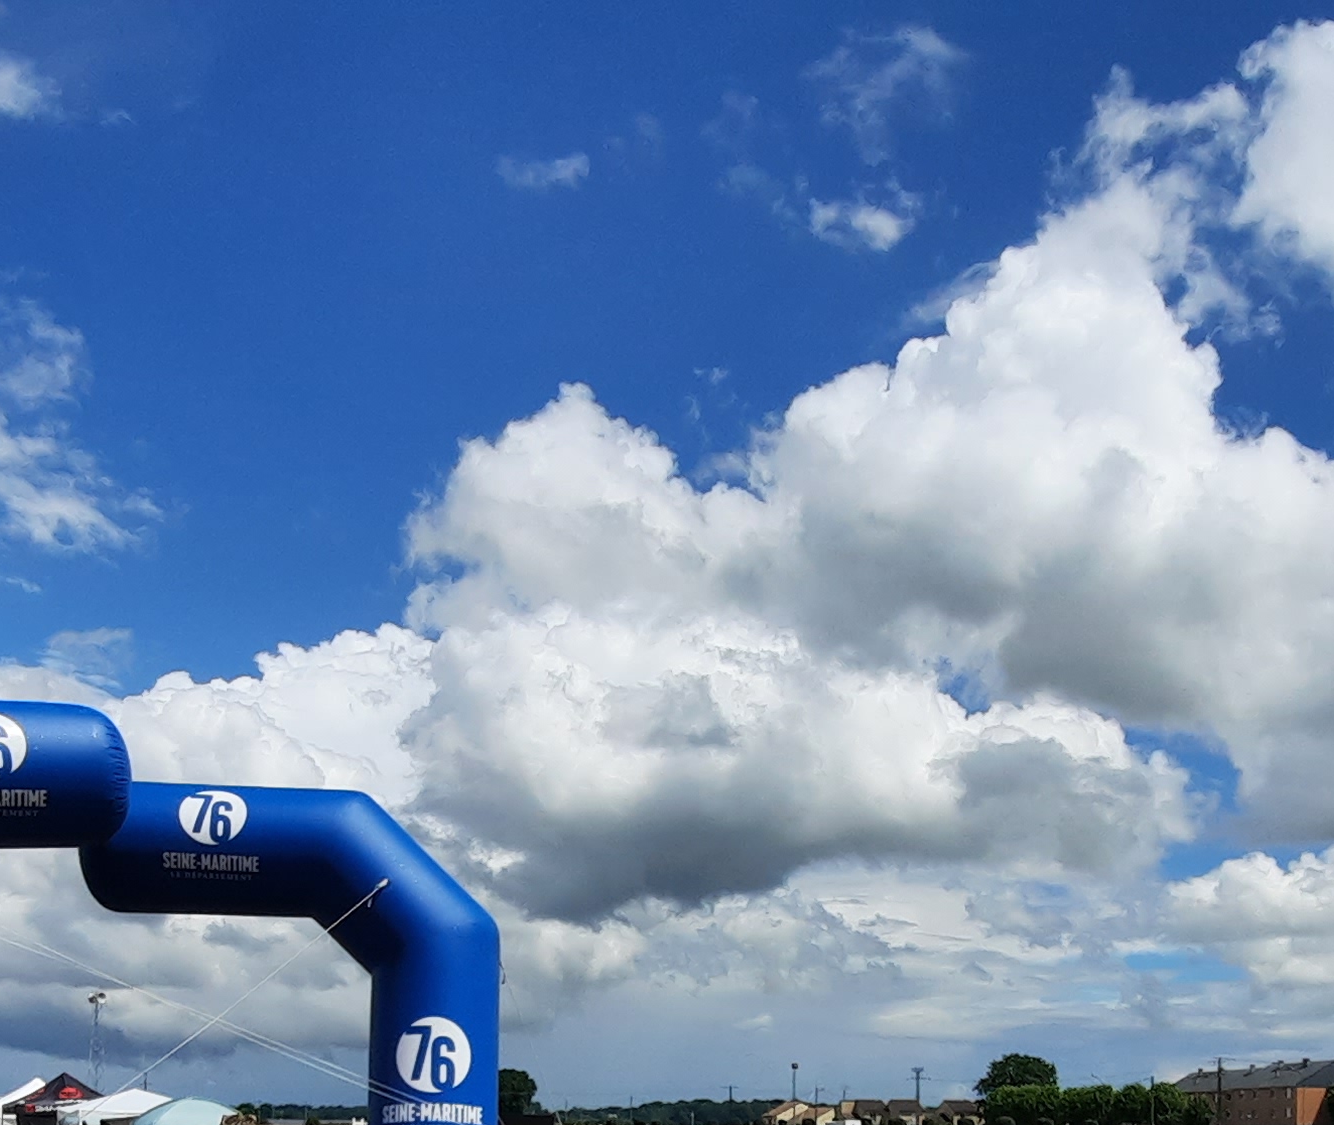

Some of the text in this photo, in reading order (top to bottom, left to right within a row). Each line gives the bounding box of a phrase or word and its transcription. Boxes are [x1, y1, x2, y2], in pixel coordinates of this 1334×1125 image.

[187, 794, 233, 844] 76
[162, 852, 260, 873] SEINE-MARITIME
[405, 1025, 456, 1092] 76
[382, 1103, 484, 1125] SEINE-MARITIME
